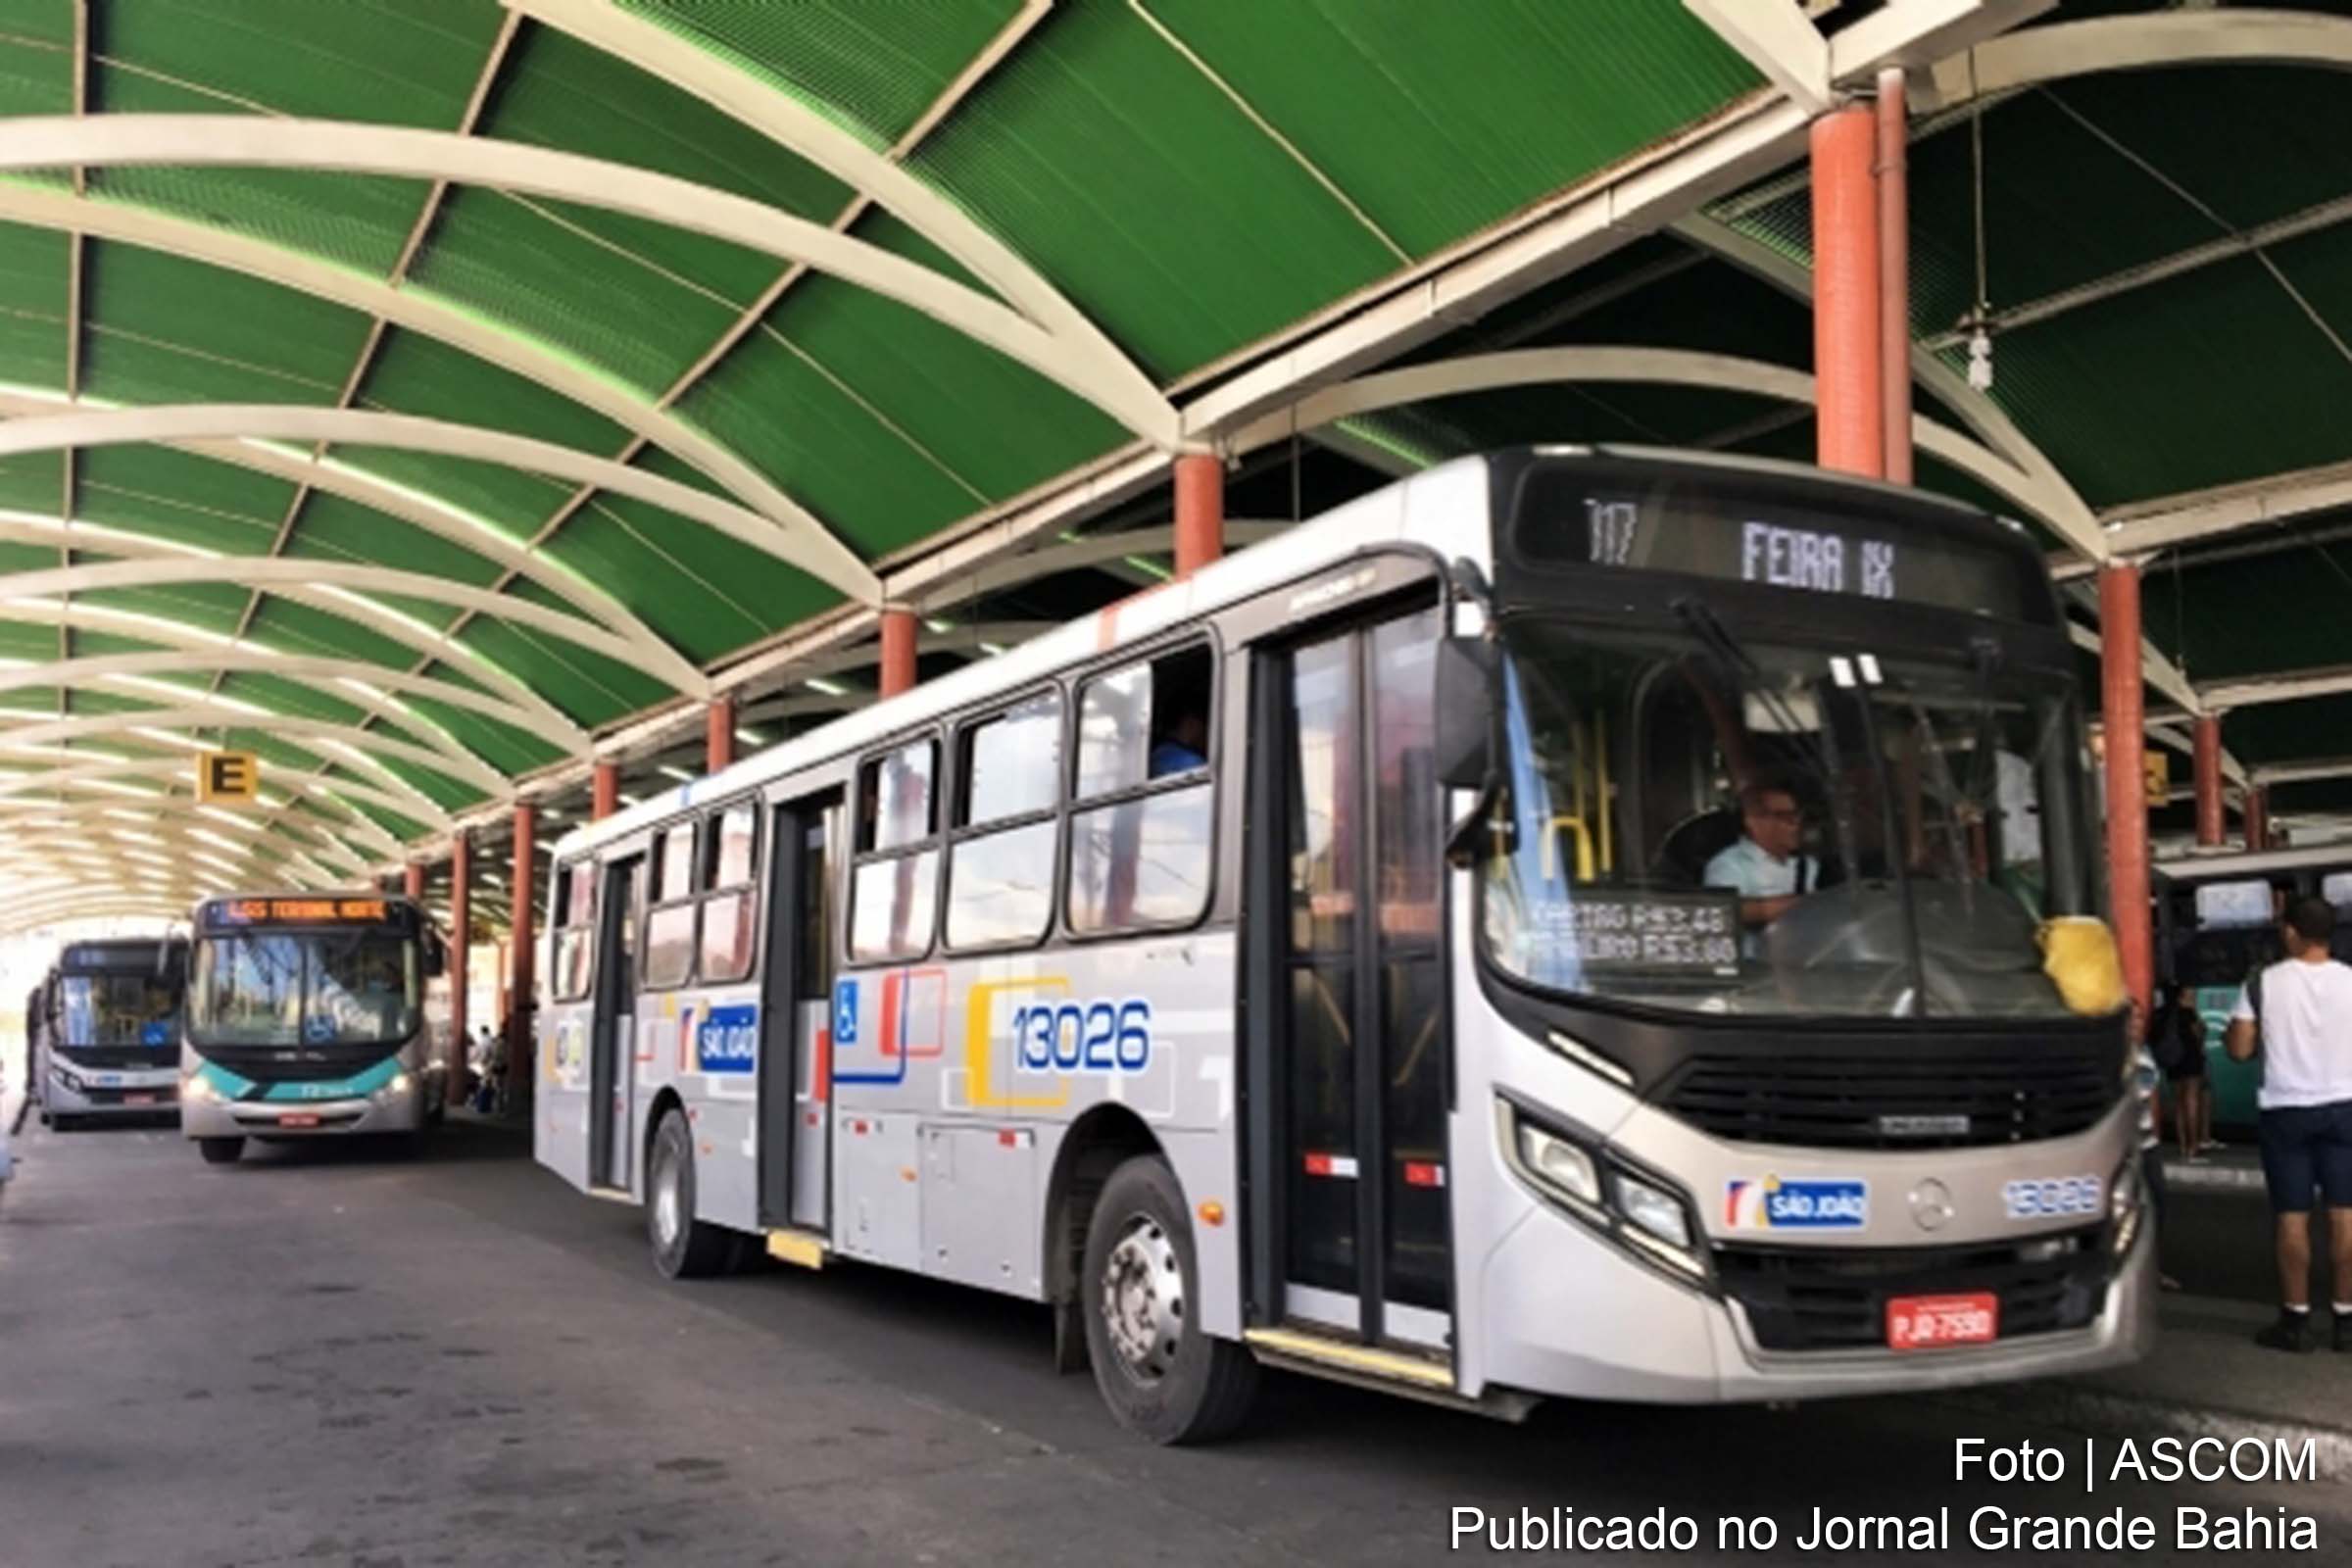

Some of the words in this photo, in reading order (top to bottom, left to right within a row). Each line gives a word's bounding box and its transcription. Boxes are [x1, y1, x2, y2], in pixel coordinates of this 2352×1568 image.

[1741, 520, 1843, 593] FEIRA
[212, 757, 247, 794] E
[1013, 1001, 1151, 1069] 13026
[1772, 1189, 1812, 1217] SÃO
[1813, 1189, 1864, 1218] JOÃO
